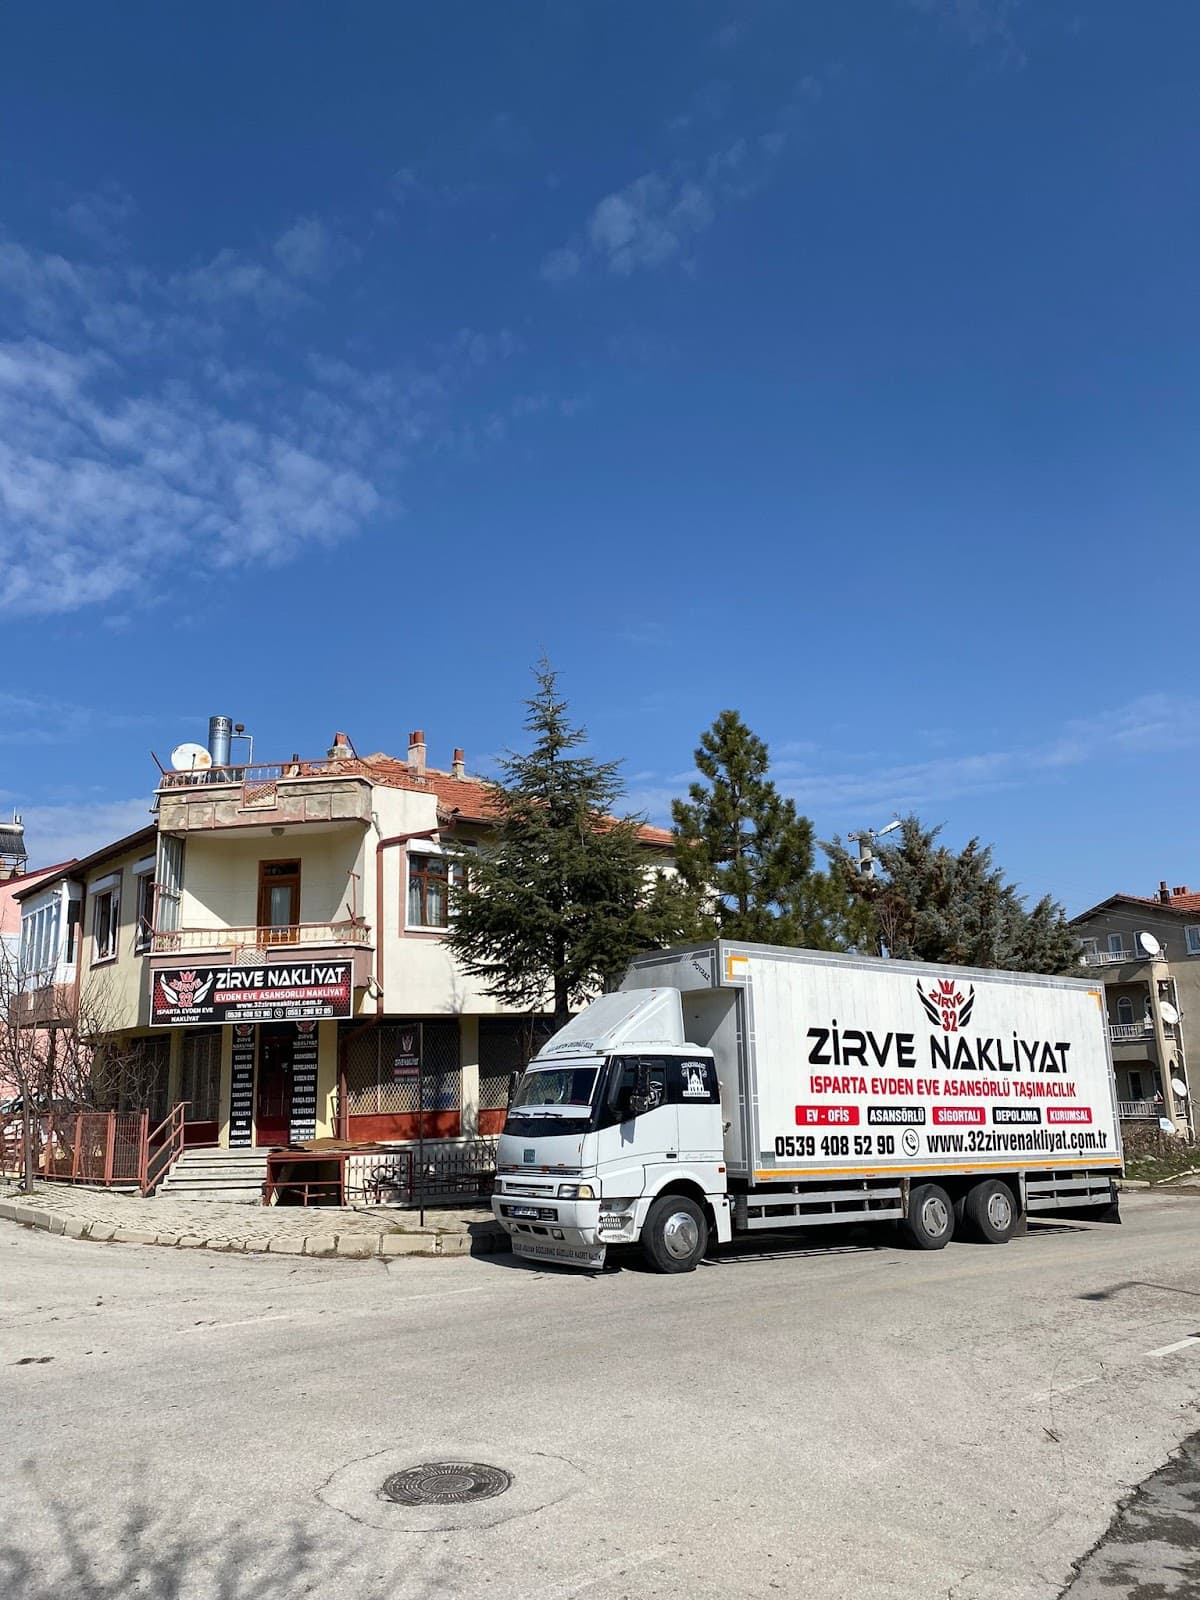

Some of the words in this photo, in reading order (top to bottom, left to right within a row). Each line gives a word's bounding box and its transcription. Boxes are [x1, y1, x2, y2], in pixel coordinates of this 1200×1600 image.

[215, 968, 265, 989] ZİRVE
[268, 964, 346, 987] NAKLİYAT
[178, 992, 193, 1007] 32
[215, 992, 242, 1001] EVDEN
[242, 991, 257, 1000] EVE
[941, 1010, 958, 1032] 32
[806, 1018, 917, 1068] ZİRVE
[930, 1030, 1071, 1073] NAKLİYAT
[810, 1075, 868, 1094] ISPARTA
[871, 1077, 914, 1095] EVDEN
[916, 1078, 940, 1096] EVE
[943, 1077, 1010, 1097] ASANSÖRLÜ
[1012, 1081, 1077, 1099] TAŞIMACILIK
[806, 1109, 818, 1122] EV
[828, 1107, 850, 1122] OFİS
[869, 1107, 924, 1122] ASANSÖRLÜ
[938, 1108, 981, 1122] SİGORTALI
[995, 1110, 1038, 1122] DEPOLAMA
[1050, 1109, 1089, 1121] KURUMSAL
[774, 1136, 815, 1157] 0539
[820, 1135, 849, 1156] 408
[854, 1135, 872, 1155] 52
[877, 1135, 895, 1154] 90
[926, 1130, 1107, 1153] www.32zirvenakliyat.com.tr
